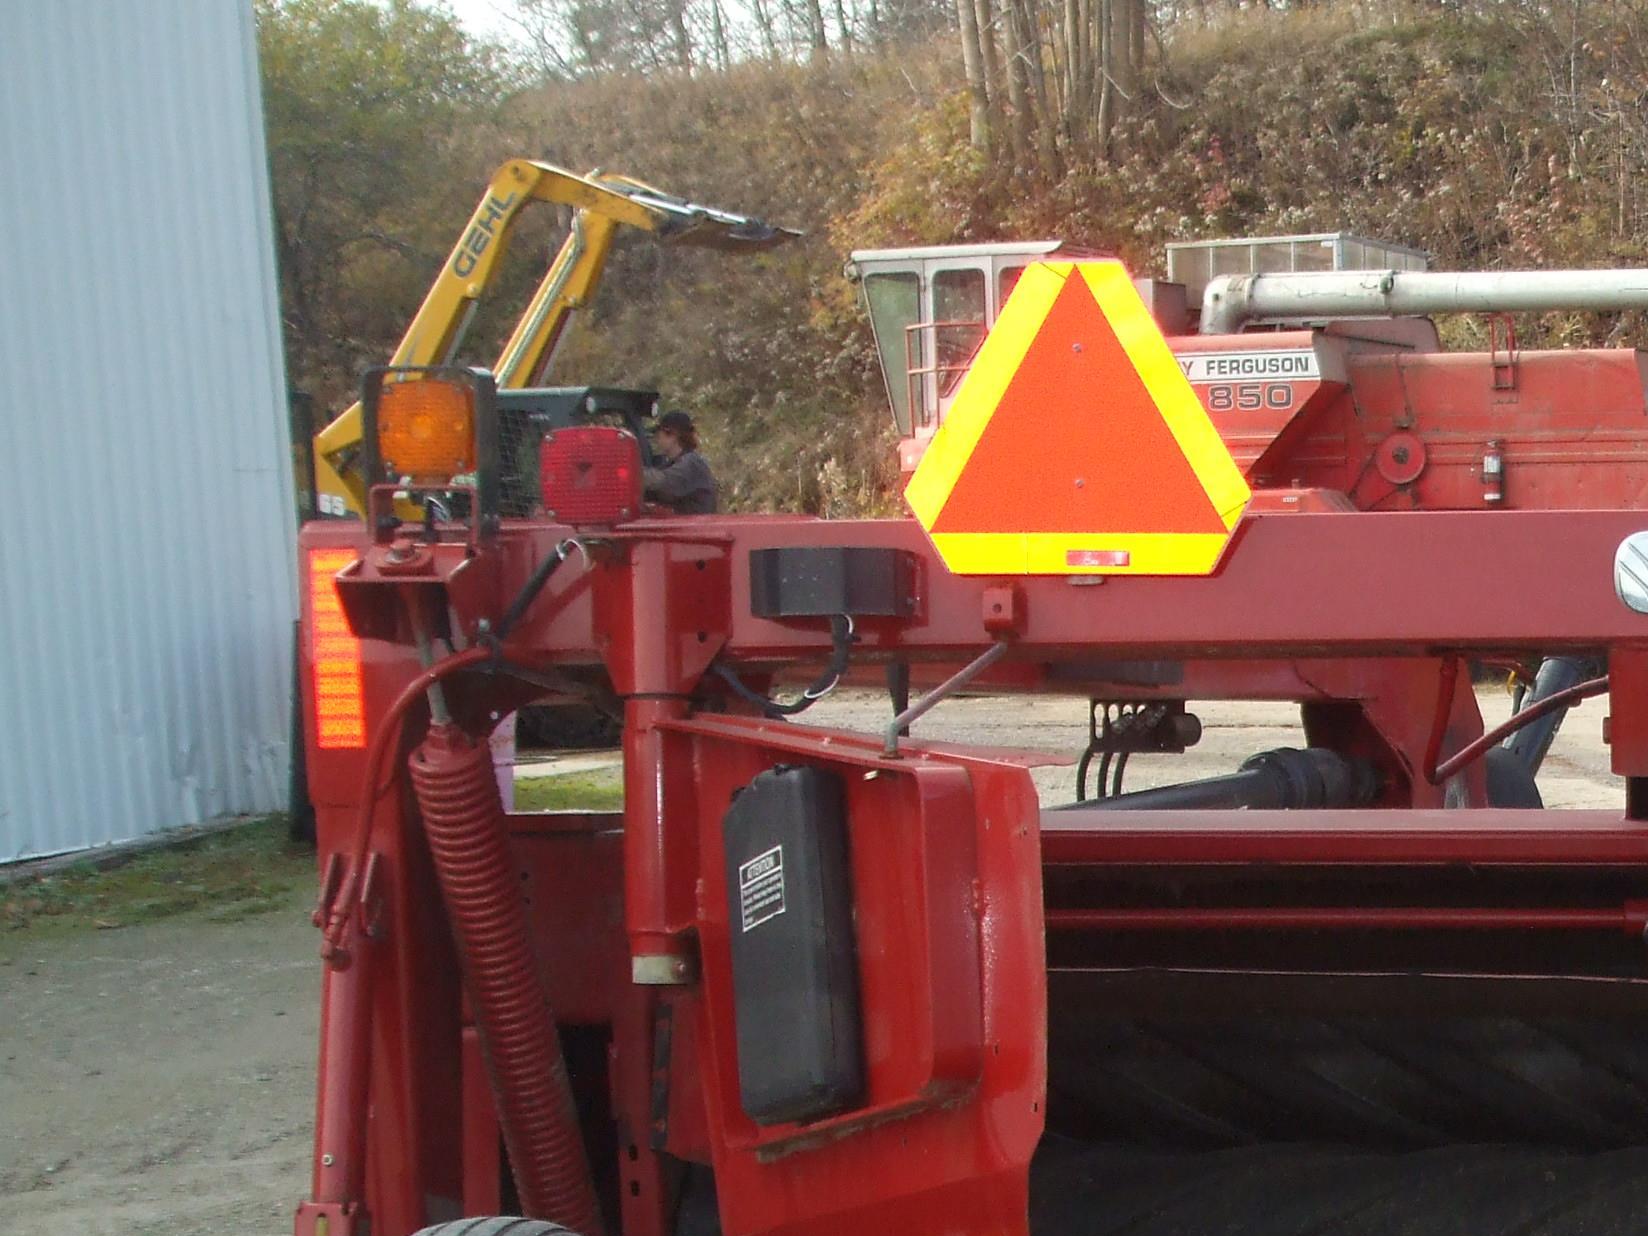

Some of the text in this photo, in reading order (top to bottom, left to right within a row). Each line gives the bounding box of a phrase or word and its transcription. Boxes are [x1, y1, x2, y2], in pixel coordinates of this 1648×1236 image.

[454, 191, 515, 277] GEHL
[1206, 356, 1309, 376] FERGUSON
[1208, 383, 1293, 411] 850
